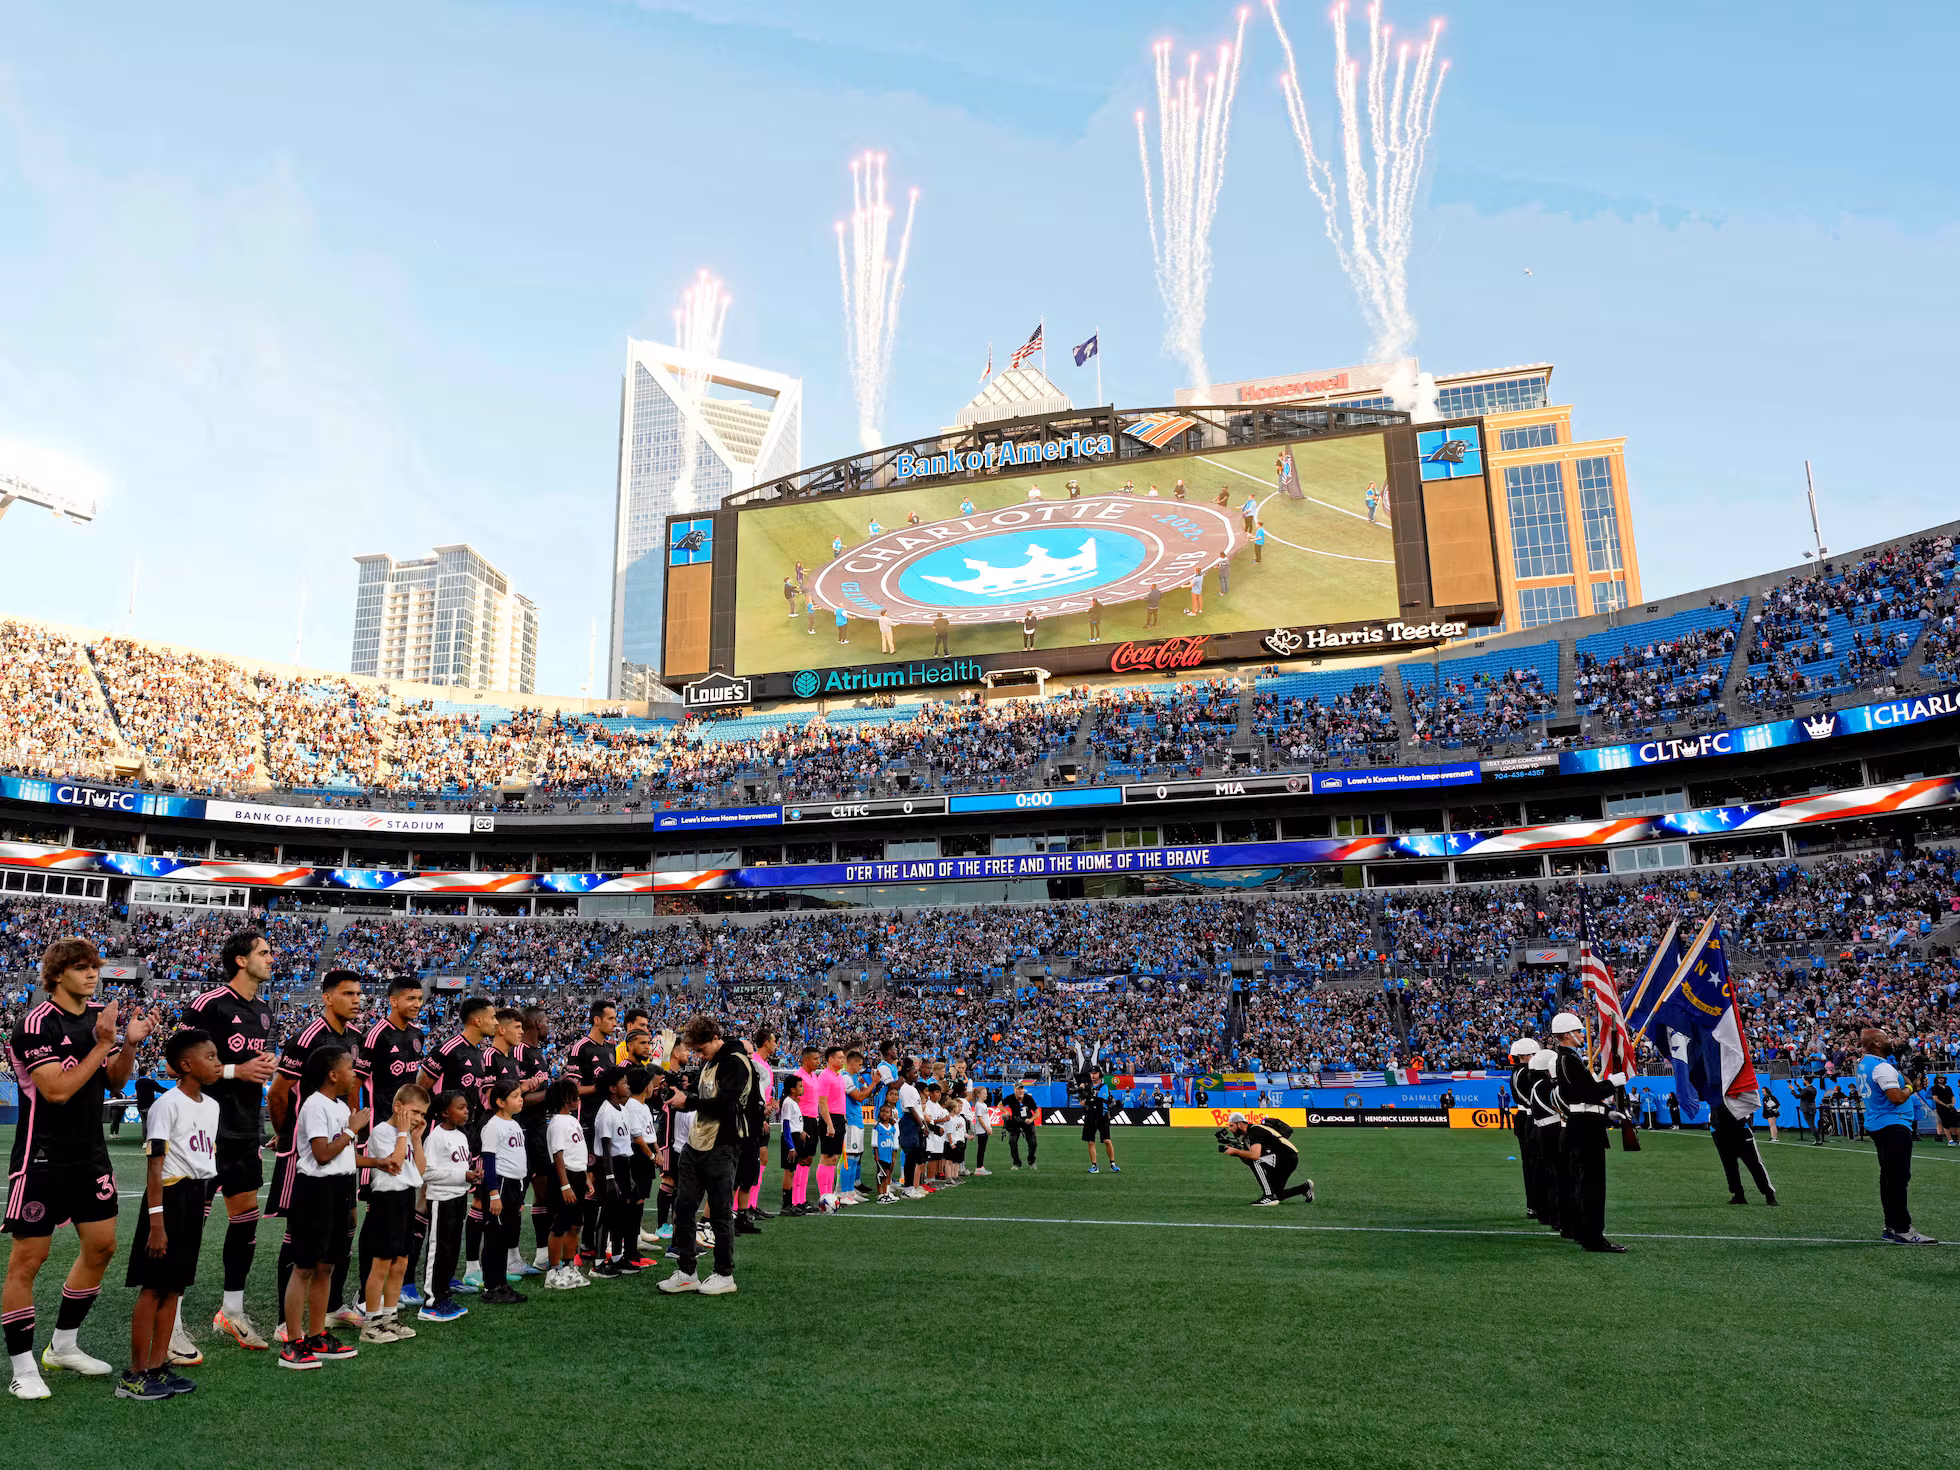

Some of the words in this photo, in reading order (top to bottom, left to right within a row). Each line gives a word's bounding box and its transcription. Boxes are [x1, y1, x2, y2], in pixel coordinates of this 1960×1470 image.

[1241, 373, 1348, 402] Honeywell
[896, 447, 964, 478] Bank
[967, 442, 997, 470] of
[998, 431, 1114, 467] America
[844, 502, 1135, 573] CHARLOTTE
[1138, 550, 1208, 586] CLUB
[1647, 606, 1659, 614] 532
[1306, 626, 1384, 649] Harris
[1386, 621, 1467, 645] Teeter
[1110, 634, 1210, 673] Coca-Cola
[825, 670, 905, 692] Atrium
[908, 659, 983, 685] Health
[690, 683, 744, 704] LOWE'S
[1874, 692, 1960, 725] CHARL
[1347, 776, 1373, 785] Lowe's
[1372, 775, 1398, 783] Knows
[1398, 774, 1421, 782] Home
[1421, 770, 1474, 781] Improvement
[1015, 792, 1053, 808] 0:00
[1156, 786, 1168, 799] 0
[1215, 783, 1246, 796] MIA
[681, 815, 701, 824] Lowe's
[700, 814, 721, 823] Knows
[720, 814, 738, 822] Home
[738, 812, 778, 822] Improvement
[831, 804, 869, 818] CLTFC
[903, 801, 913, 815] 0
[235, 810, 271, 822] BANK
[275, 814, 292, 824] OF
[387, 820, 444, 831] STADIUM
[846, 866, 873, 881] O'ER
[876, 864, 898, 880] THE
[902, 863, 935, 879] LAND
[938, 862, 954, 877] OF
[958, 860, 981, 876] THE
[985, 858, 1015, 875] FREE
[1019, 857, 1045, 874] AND
[1049, 856, 1073, 872] THE
[1077, 854, 1112, 871] HOME
[1117, 853, 1133, 869] OF
[1137, 851, 1162, 868] THE
[1166, 849, 1210, 867] BRAVE
[1694, 959, 1709, 977] N
[733, 985, 755, 993] MINT
[757, 985, 777, 993] CITY
[25, 1045, 53, 1059] Fracht
[1402, 1094, 1440, 1102] DAIMLE
[1453, 1094, 1479, 1102] RUCK
[1321, 1115, 1355, 1123] LEXUS
[1364, 1115, 1397, 1123] HENDRICK
[1398, 1115, 1418, 1123] LEXUS
[1419, 1115, 1448, 1123] DEALERS
[190, 1130, 214, 1160] ally
[96, 1171, 118, 1200] 3
